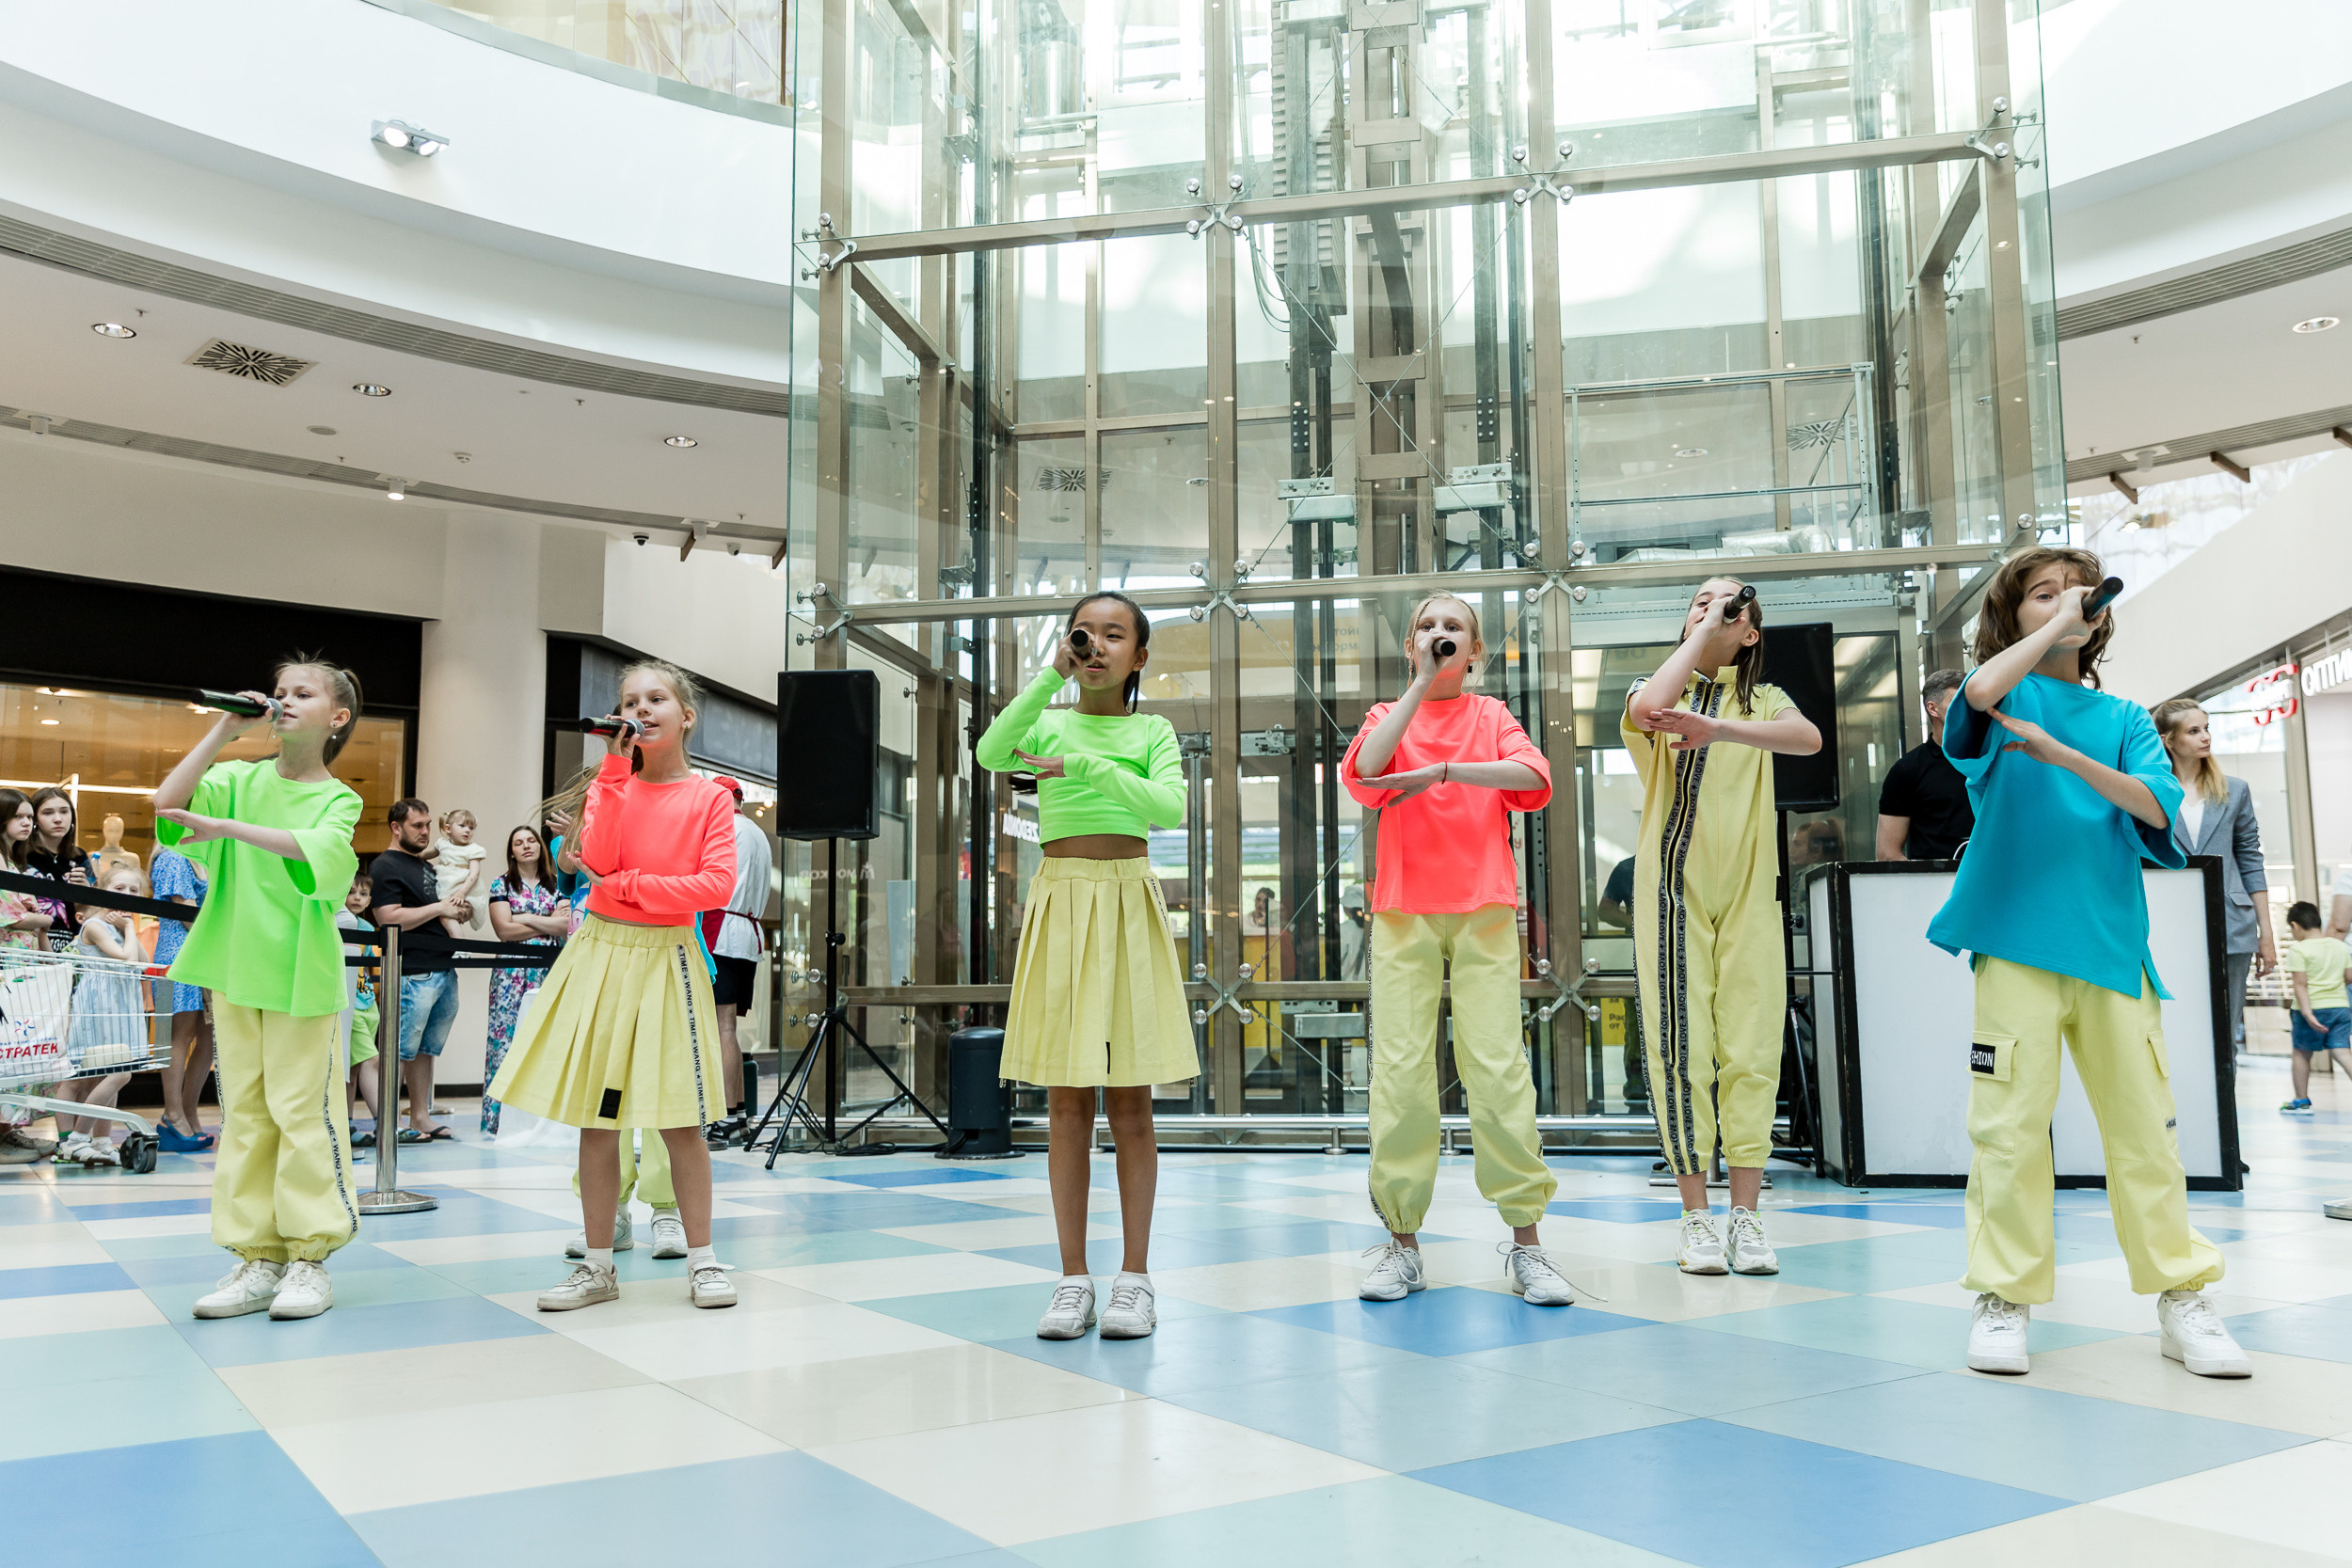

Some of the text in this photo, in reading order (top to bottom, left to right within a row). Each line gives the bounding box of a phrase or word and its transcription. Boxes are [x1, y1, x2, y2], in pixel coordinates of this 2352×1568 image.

[2301, 647, 2352, 697] ОПТИ
[1692, 764, 1703, 782] LOVE
[1668, 808, 1678, 827] LOVE
[1685, 820, 1693, 839] LOVE
[1677, 849, 1686, 868] LOVE
[679, 952, 689, 973] TIME
[685, 981, 693, 1006] WANG
[326, 1118, 335, 1136] TIME
[333, 1144, 342, 1169] WANG
[338, 1180, 347, 1199] TIME
[348, 1207, 358, 1232] WANG
